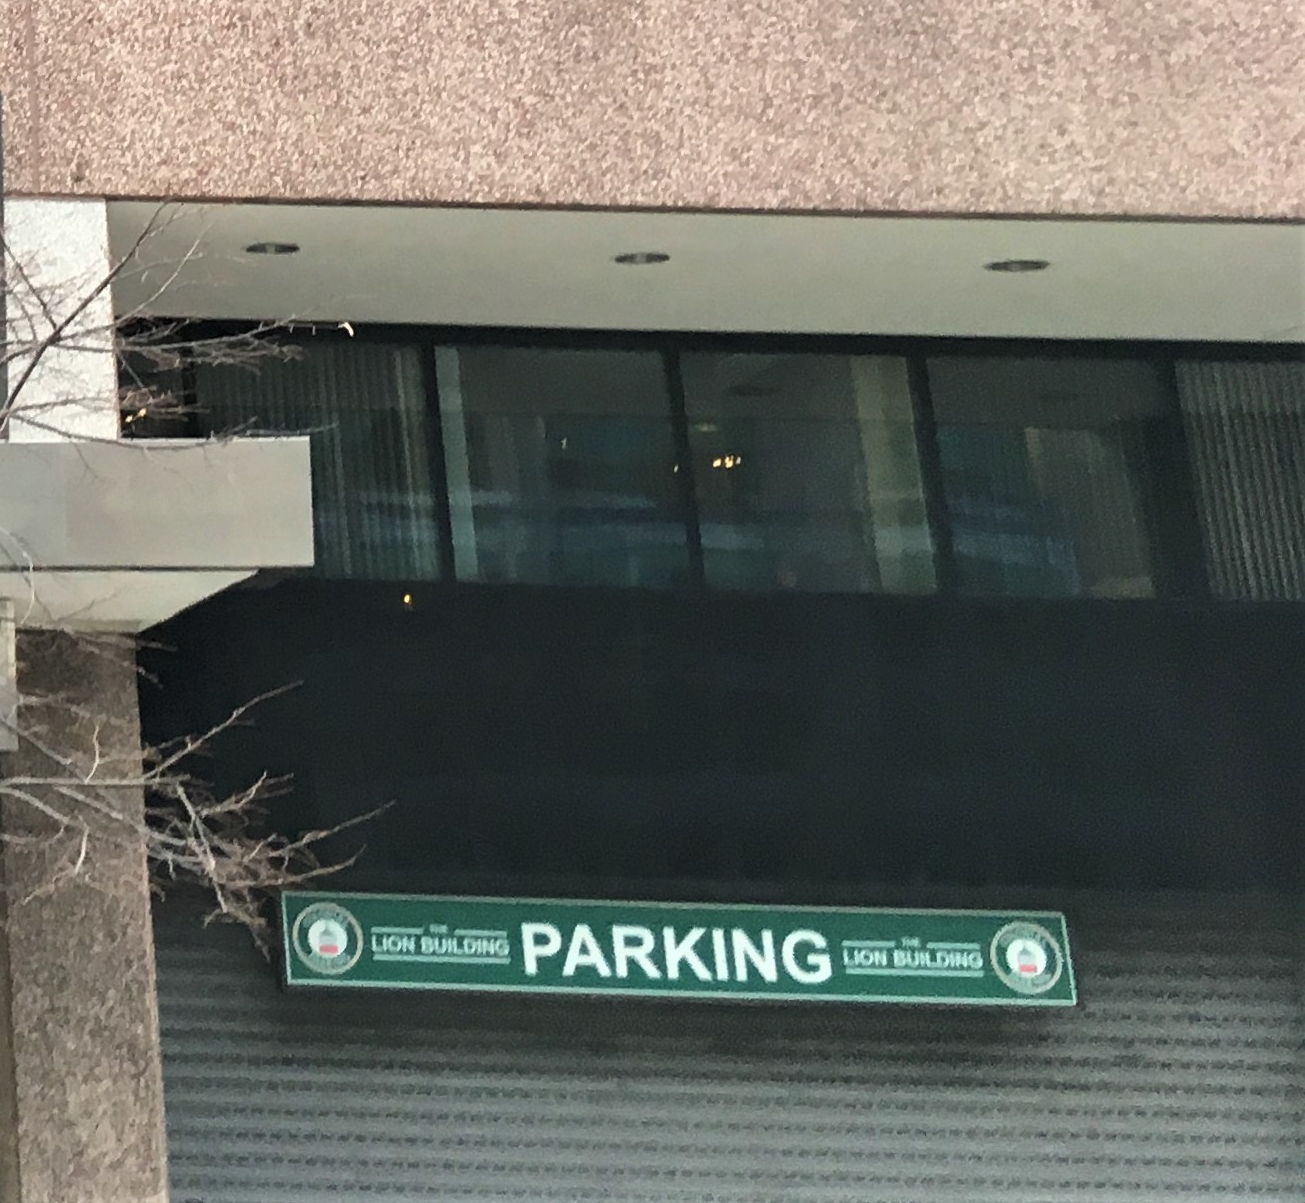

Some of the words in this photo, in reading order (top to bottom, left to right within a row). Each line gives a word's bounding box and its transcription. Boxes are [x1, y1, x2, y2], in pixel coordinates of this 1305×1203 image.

[371, 934, 416, 954] LION
[420, 935, 510, 957] BUILDING
[520, 922, 833, 985] PARKING
[842, 948, 887, 967] LION
[893, 949, 984, 970] BUILDING
